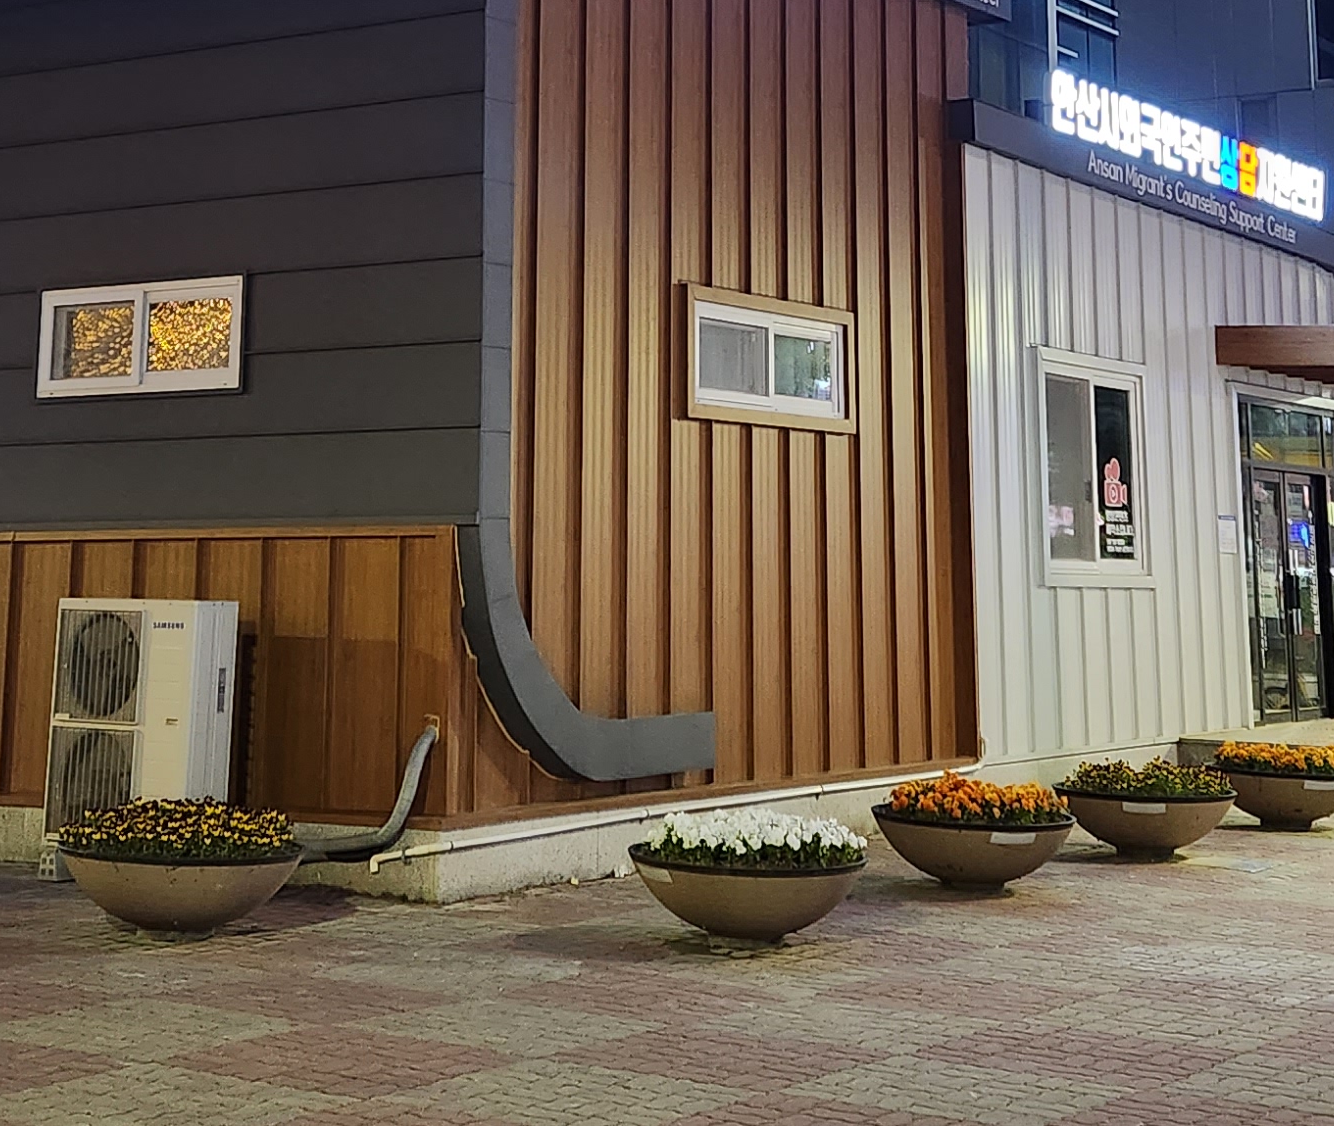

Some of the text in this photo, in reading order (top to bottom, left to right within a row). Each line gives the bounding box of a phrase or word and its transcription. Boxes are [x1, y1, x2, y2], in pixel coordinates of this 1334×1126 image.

[1087, 149, 1124, 184] Ansan
[1174, 180, 1228, 225] Counseling
[1228, 200, 1265, 235] Support
[1266, 215, 1297, 244] Center
